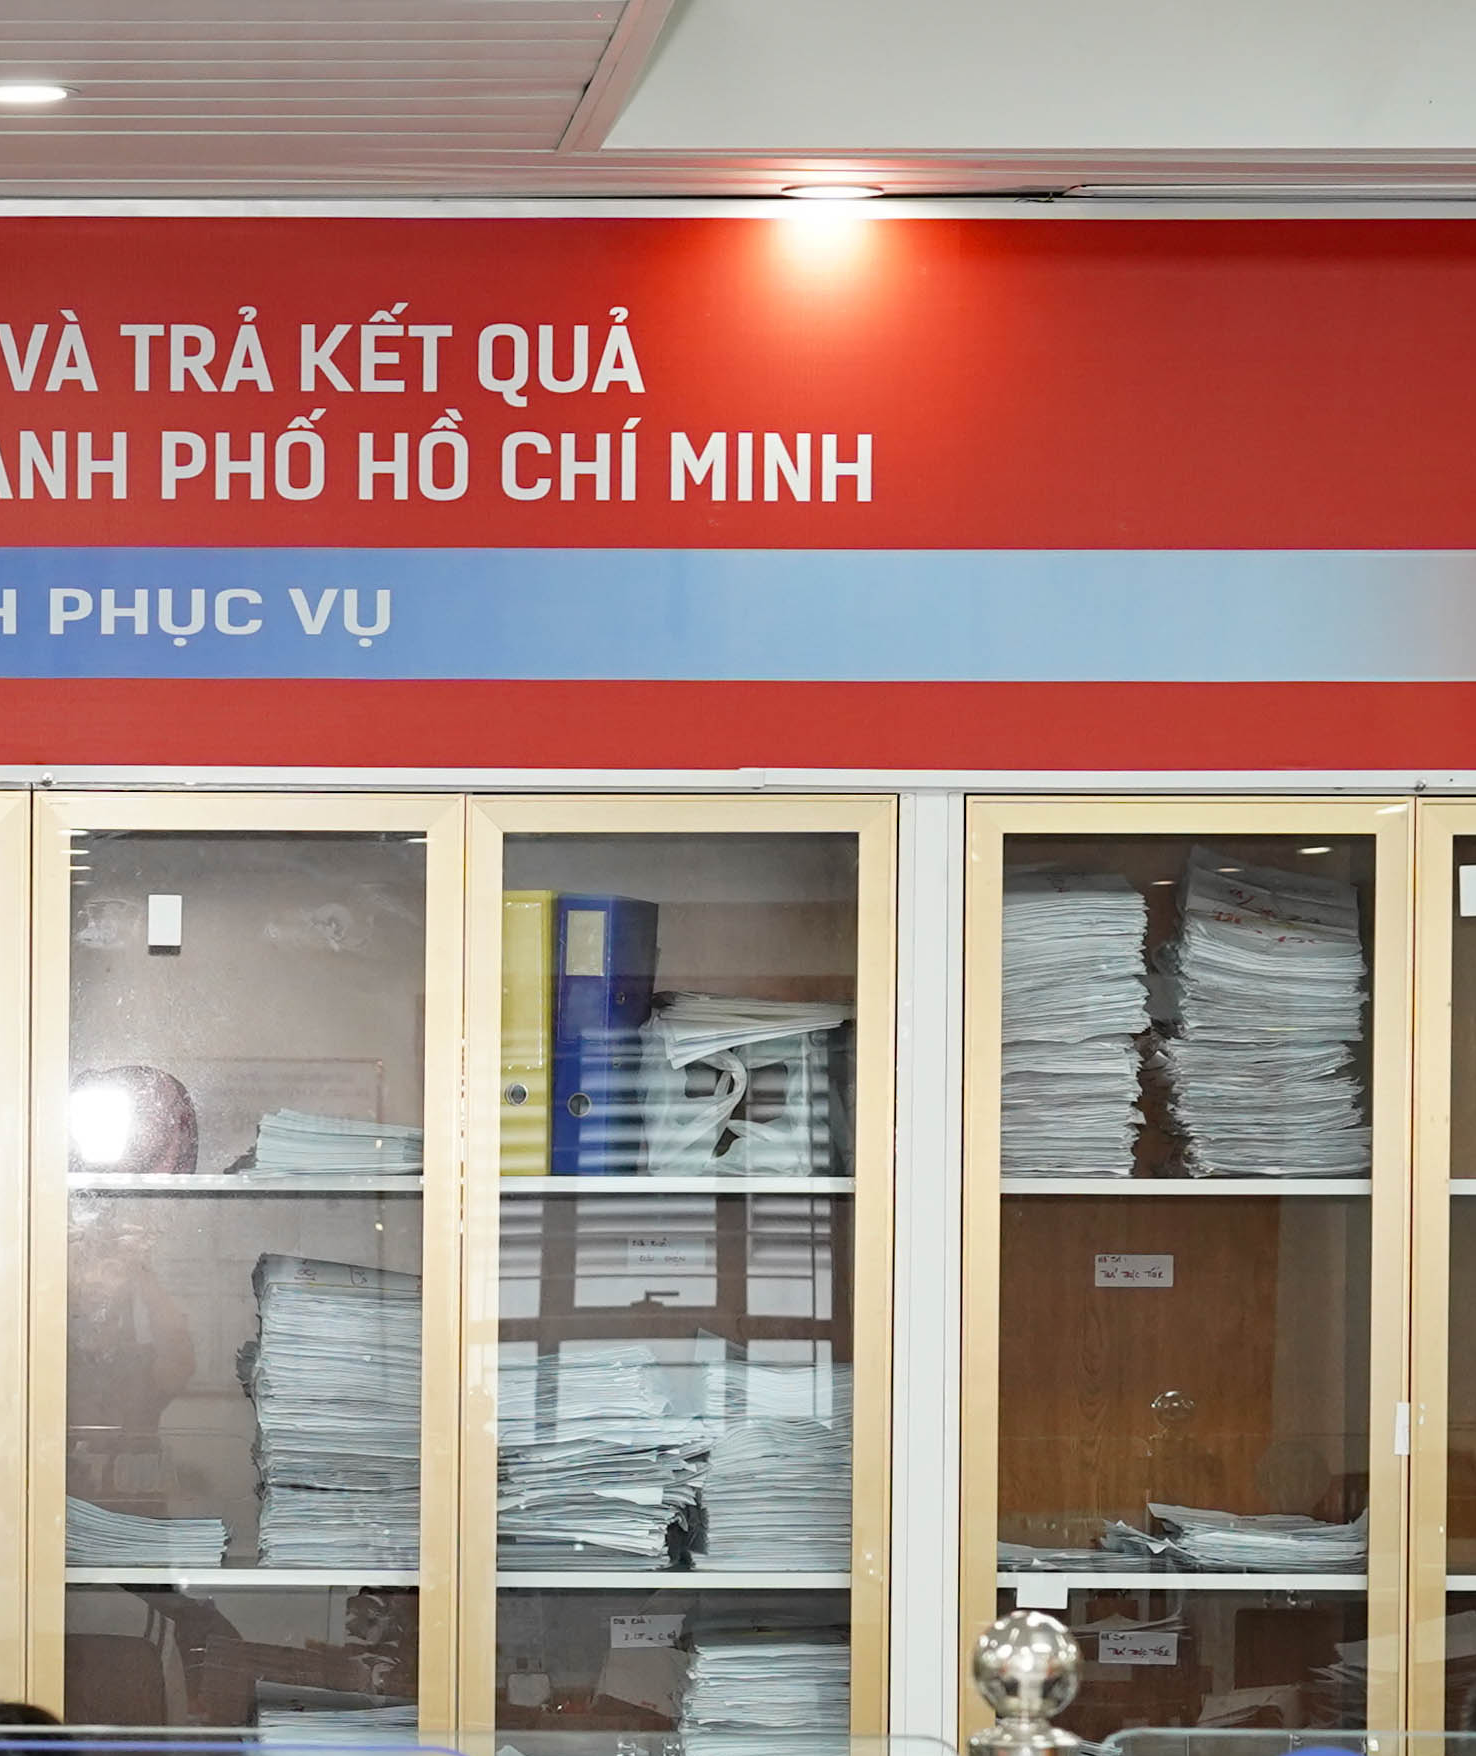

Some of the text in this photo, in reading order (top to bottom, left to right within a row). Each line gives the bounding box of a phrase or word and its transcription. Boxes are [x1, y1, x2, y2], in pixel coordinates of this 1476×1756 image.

[119, 305, 275, 393] TRẢ
[300, 301, 453, 393] KẾT
[477, 306, 647, 408] QUẢ
[160, 408, 327, 501] PHỐ
[361, 408, 470, 501] HỒ
[501, 417, 642, 502] CHÍ
[669, 431, 873, 503] MINH
[49, 586, 264, 648] PHỤC
[287, 586, 393, 648] VỤ
